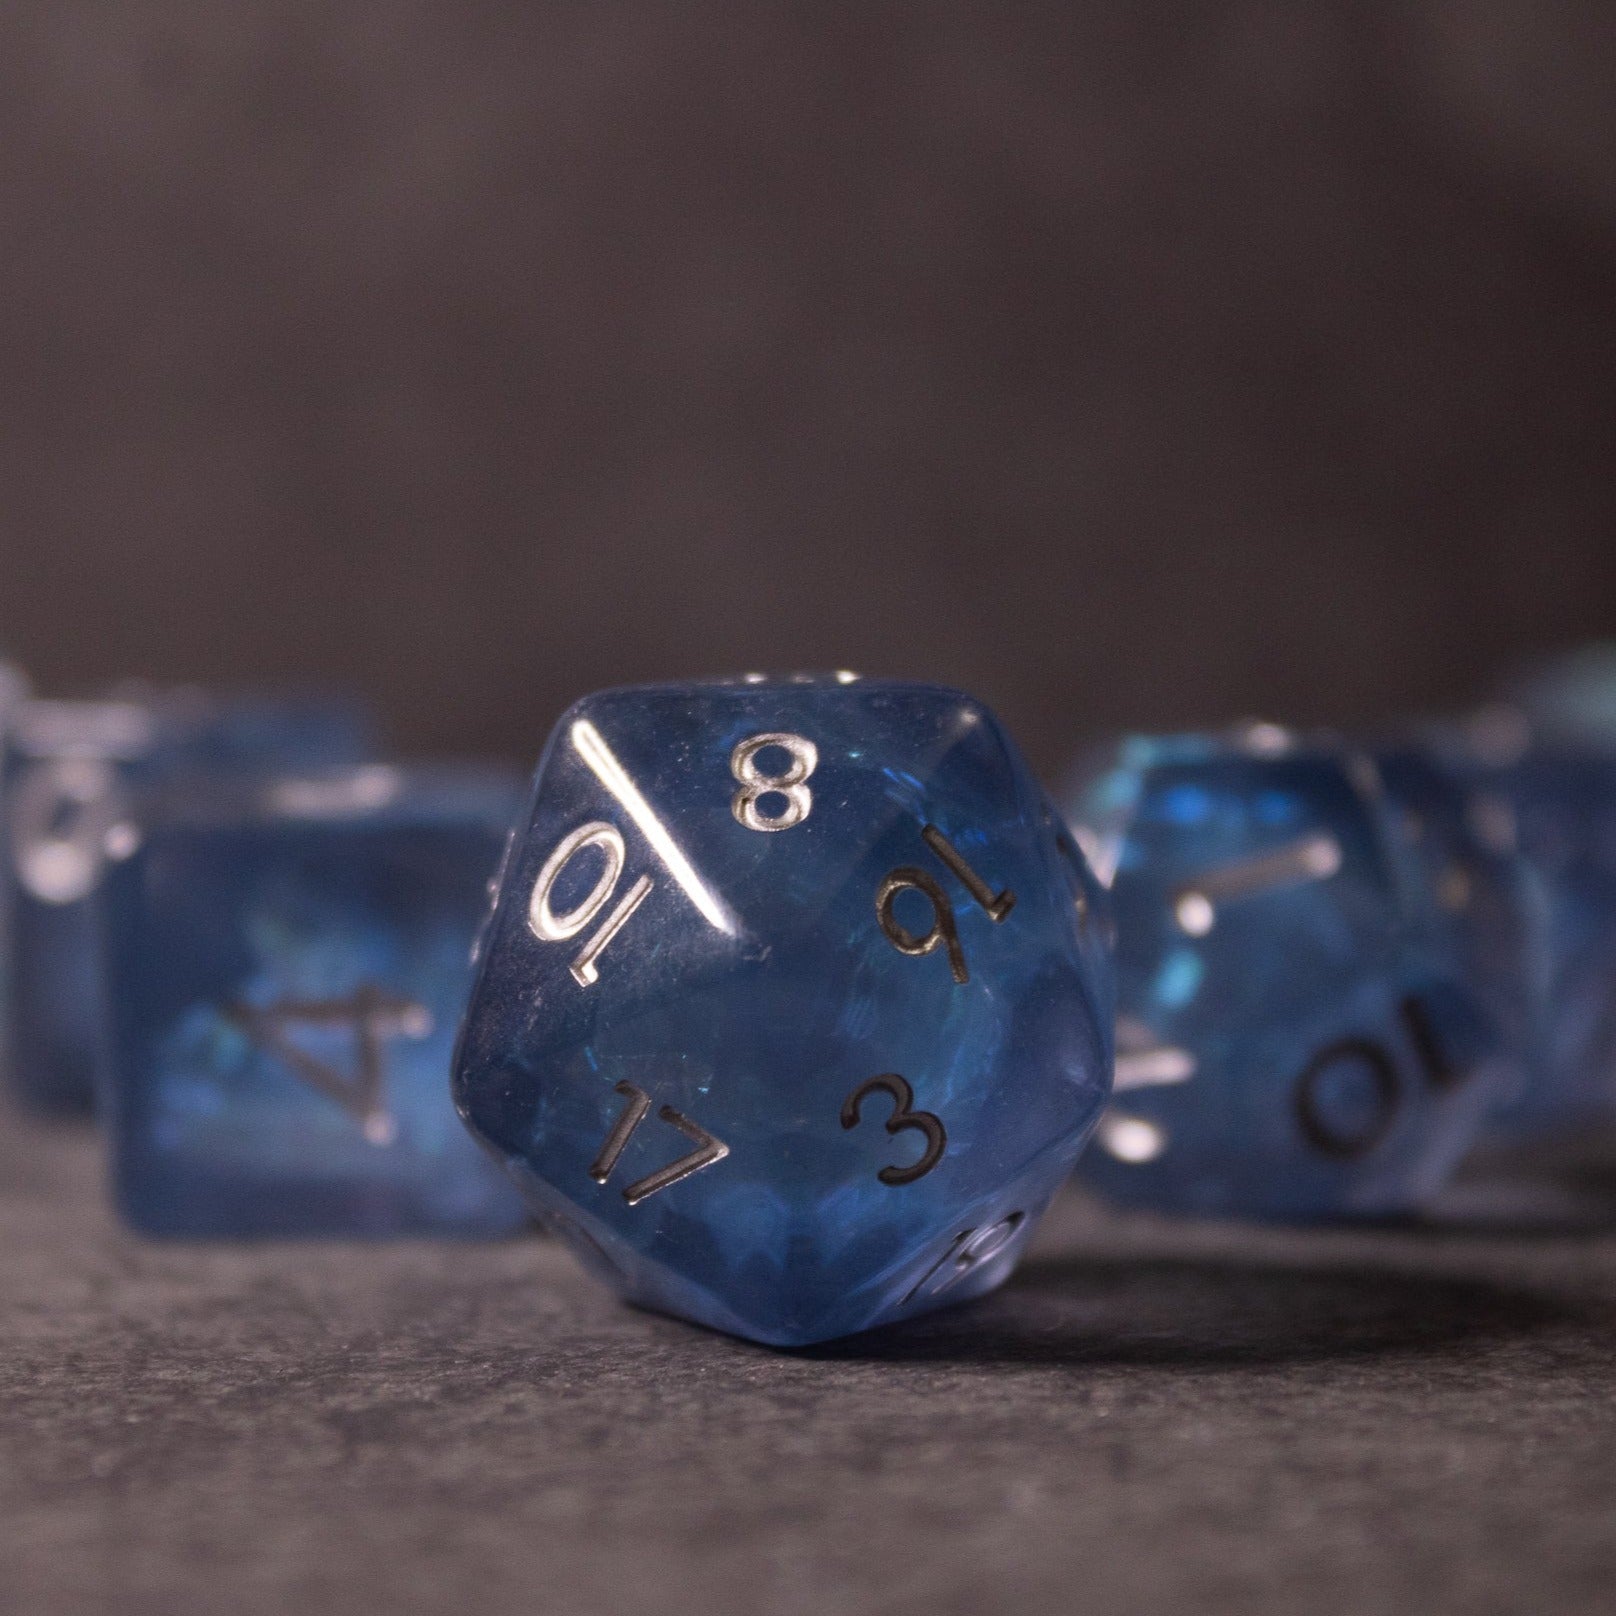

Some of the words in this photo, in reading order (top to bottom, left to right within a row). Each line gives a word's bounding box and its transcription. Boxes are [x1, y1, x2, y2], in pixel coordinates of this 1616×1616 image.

[730, 732, 819, 832] 8
[529, 820, 654, 988] 10
[875, 823, 1016, 984] 16
[224, 984, 434, 1146] 4
[589, 1078, 730, 1207] 17
[839, 1073, 947, 1186] 3
[1292, 992, 1458, 1162] 10
